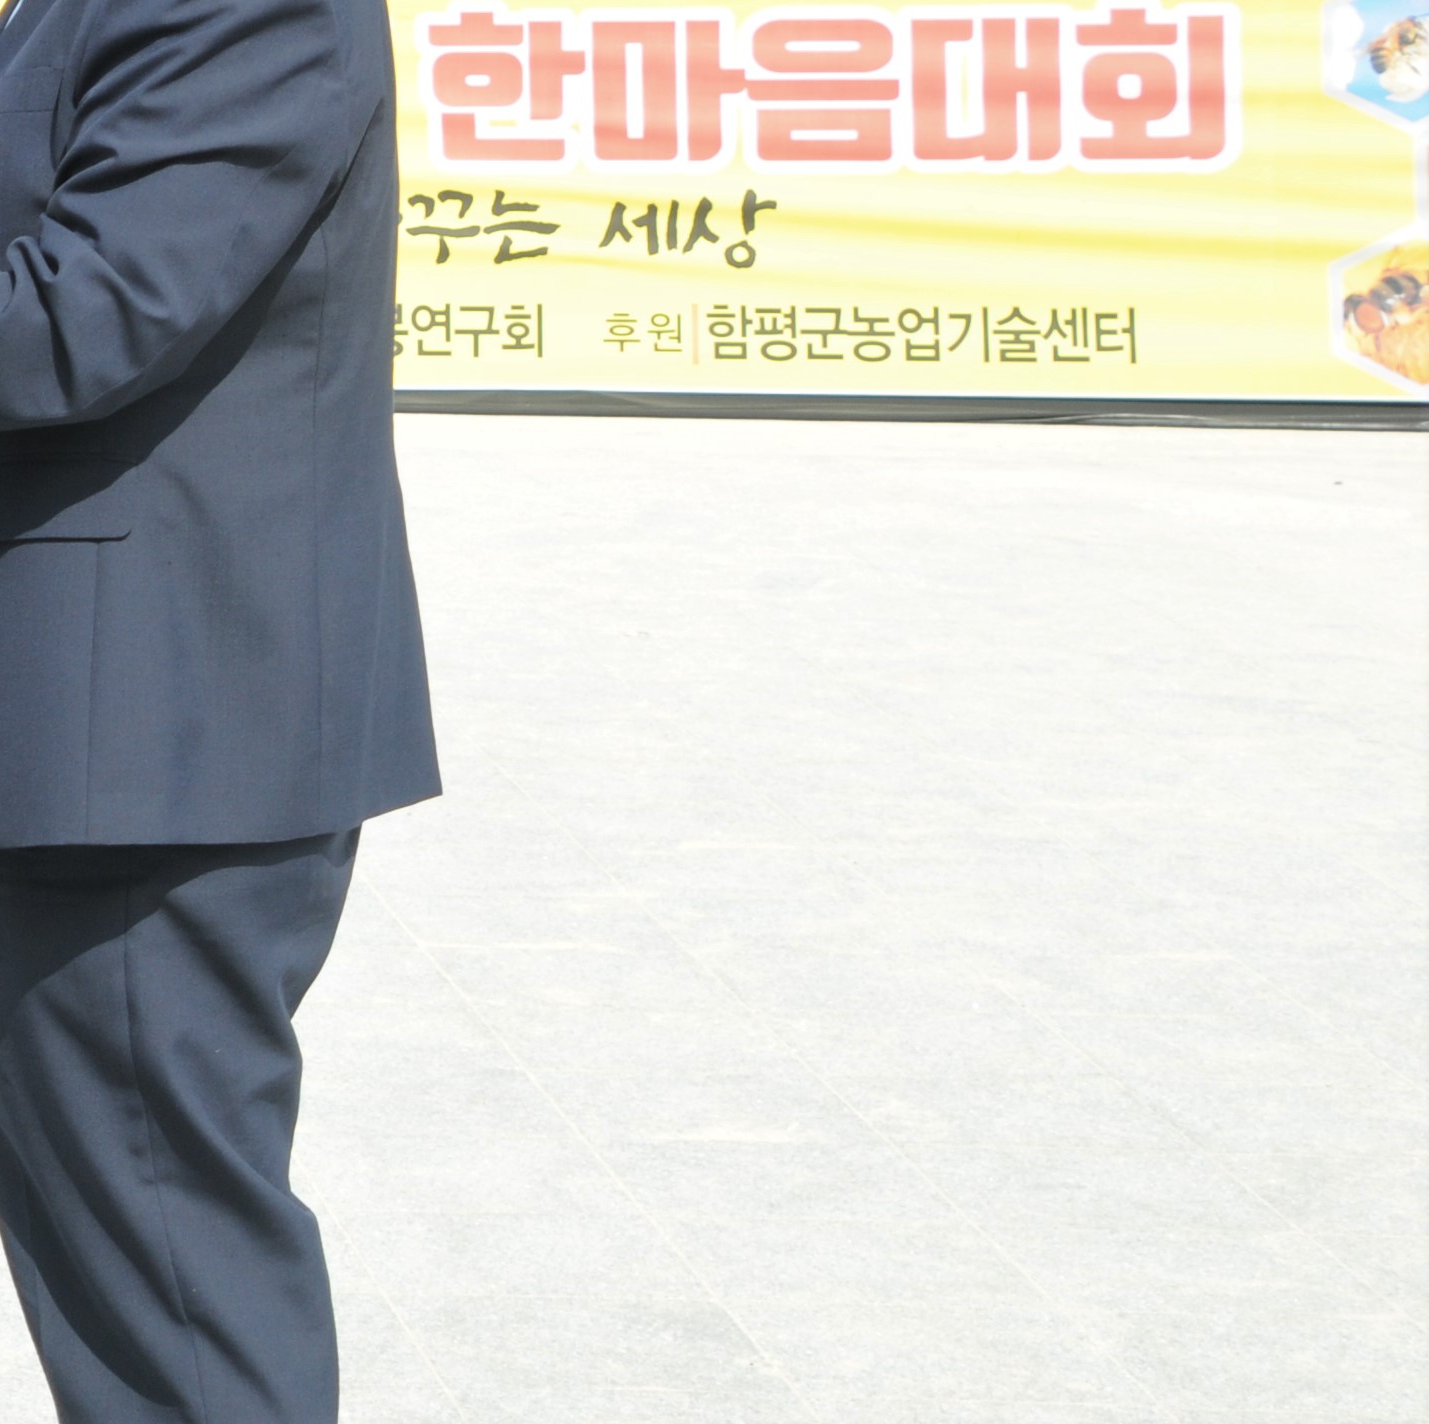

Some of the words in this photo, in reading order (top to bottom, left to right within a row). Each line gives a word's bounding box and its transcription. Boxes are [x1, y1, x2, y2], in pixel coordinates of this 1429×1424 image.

[427, 7, 1230, 163] 한마음대회
[398, 189, 562, 264] 꾸는
[599, 188, 778, 270] 세상
[393, 302, 544, 359] 연구회
[602, 312, 684, 354] 후원
[705, 302, 1141, 366] 함평군농업기술센터
